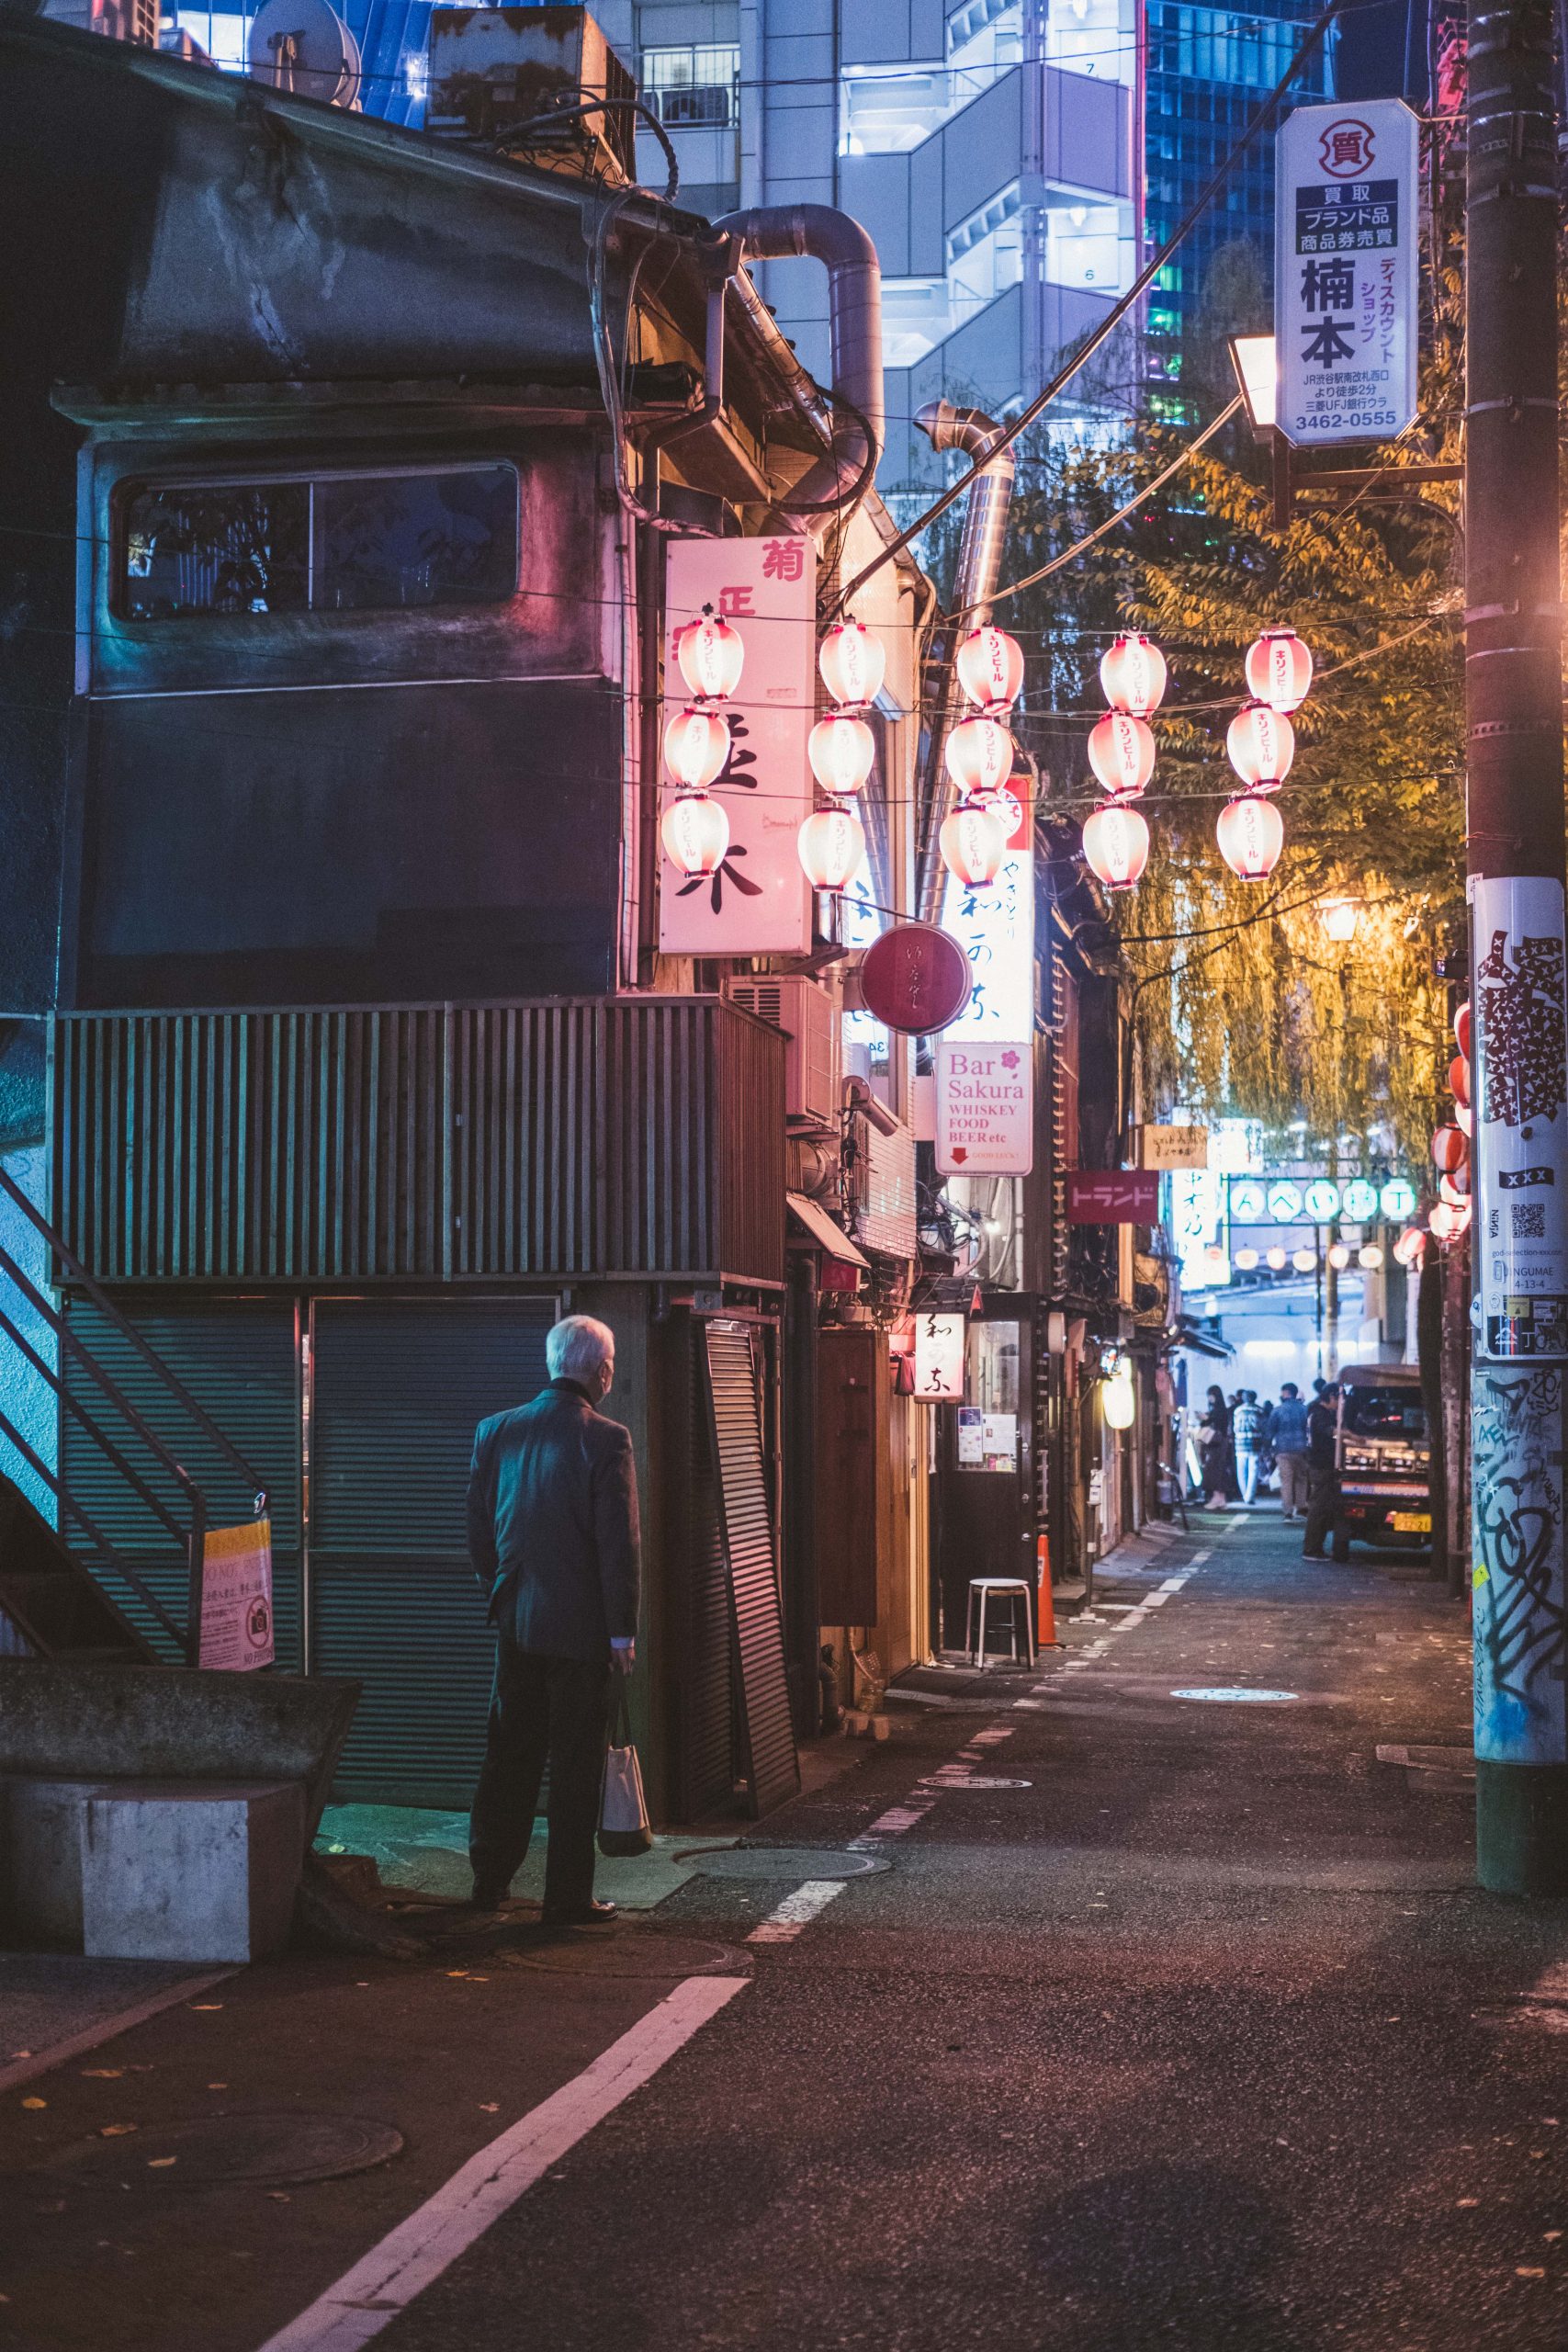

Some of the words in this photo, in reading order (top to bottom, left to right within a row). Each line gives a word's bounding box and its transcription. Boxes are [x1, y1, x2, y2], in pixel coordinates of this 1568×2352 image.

[1087, 63, 1094, 74] 7
[1331, 130, 1362, 167] 質
[1325, 185, 1371, 205] 買取
[1305, 207, 1389, 230] ブランド品
[1301, 229, 1393, 253] 商品券売買
[1085, 269, 1094, 280] 6
[1301, 257, 1356, 369] 楠本
[1360, 282, 1376, 344] ショップ
[1380, 257, 1395, 364] ディスカウント
[1303, 369, 1389, 386] JR渋谷駅南改札西口
[1314, 384, 1377, 398] より徒歩2分
[1305, 397, 1387, 413] 三菱UFJ銀行ウラ
[1296, 411, 1396, 430] 3462-0555
[949, 1054, 996, 1075] Bar
[949, 1080, 1024, 1099] Sakura
[949, 1104, 1017, 1115] WHISKEY
[949, 1118, 989, 1128] FOOD
[949, 1132, 987, 1142] BEER
[989, 1133, 1007, 1143] etc
[1073, 1186, 1154, 1206] トランド
[1515, 1280, 1545, 1289] 4-13-4
